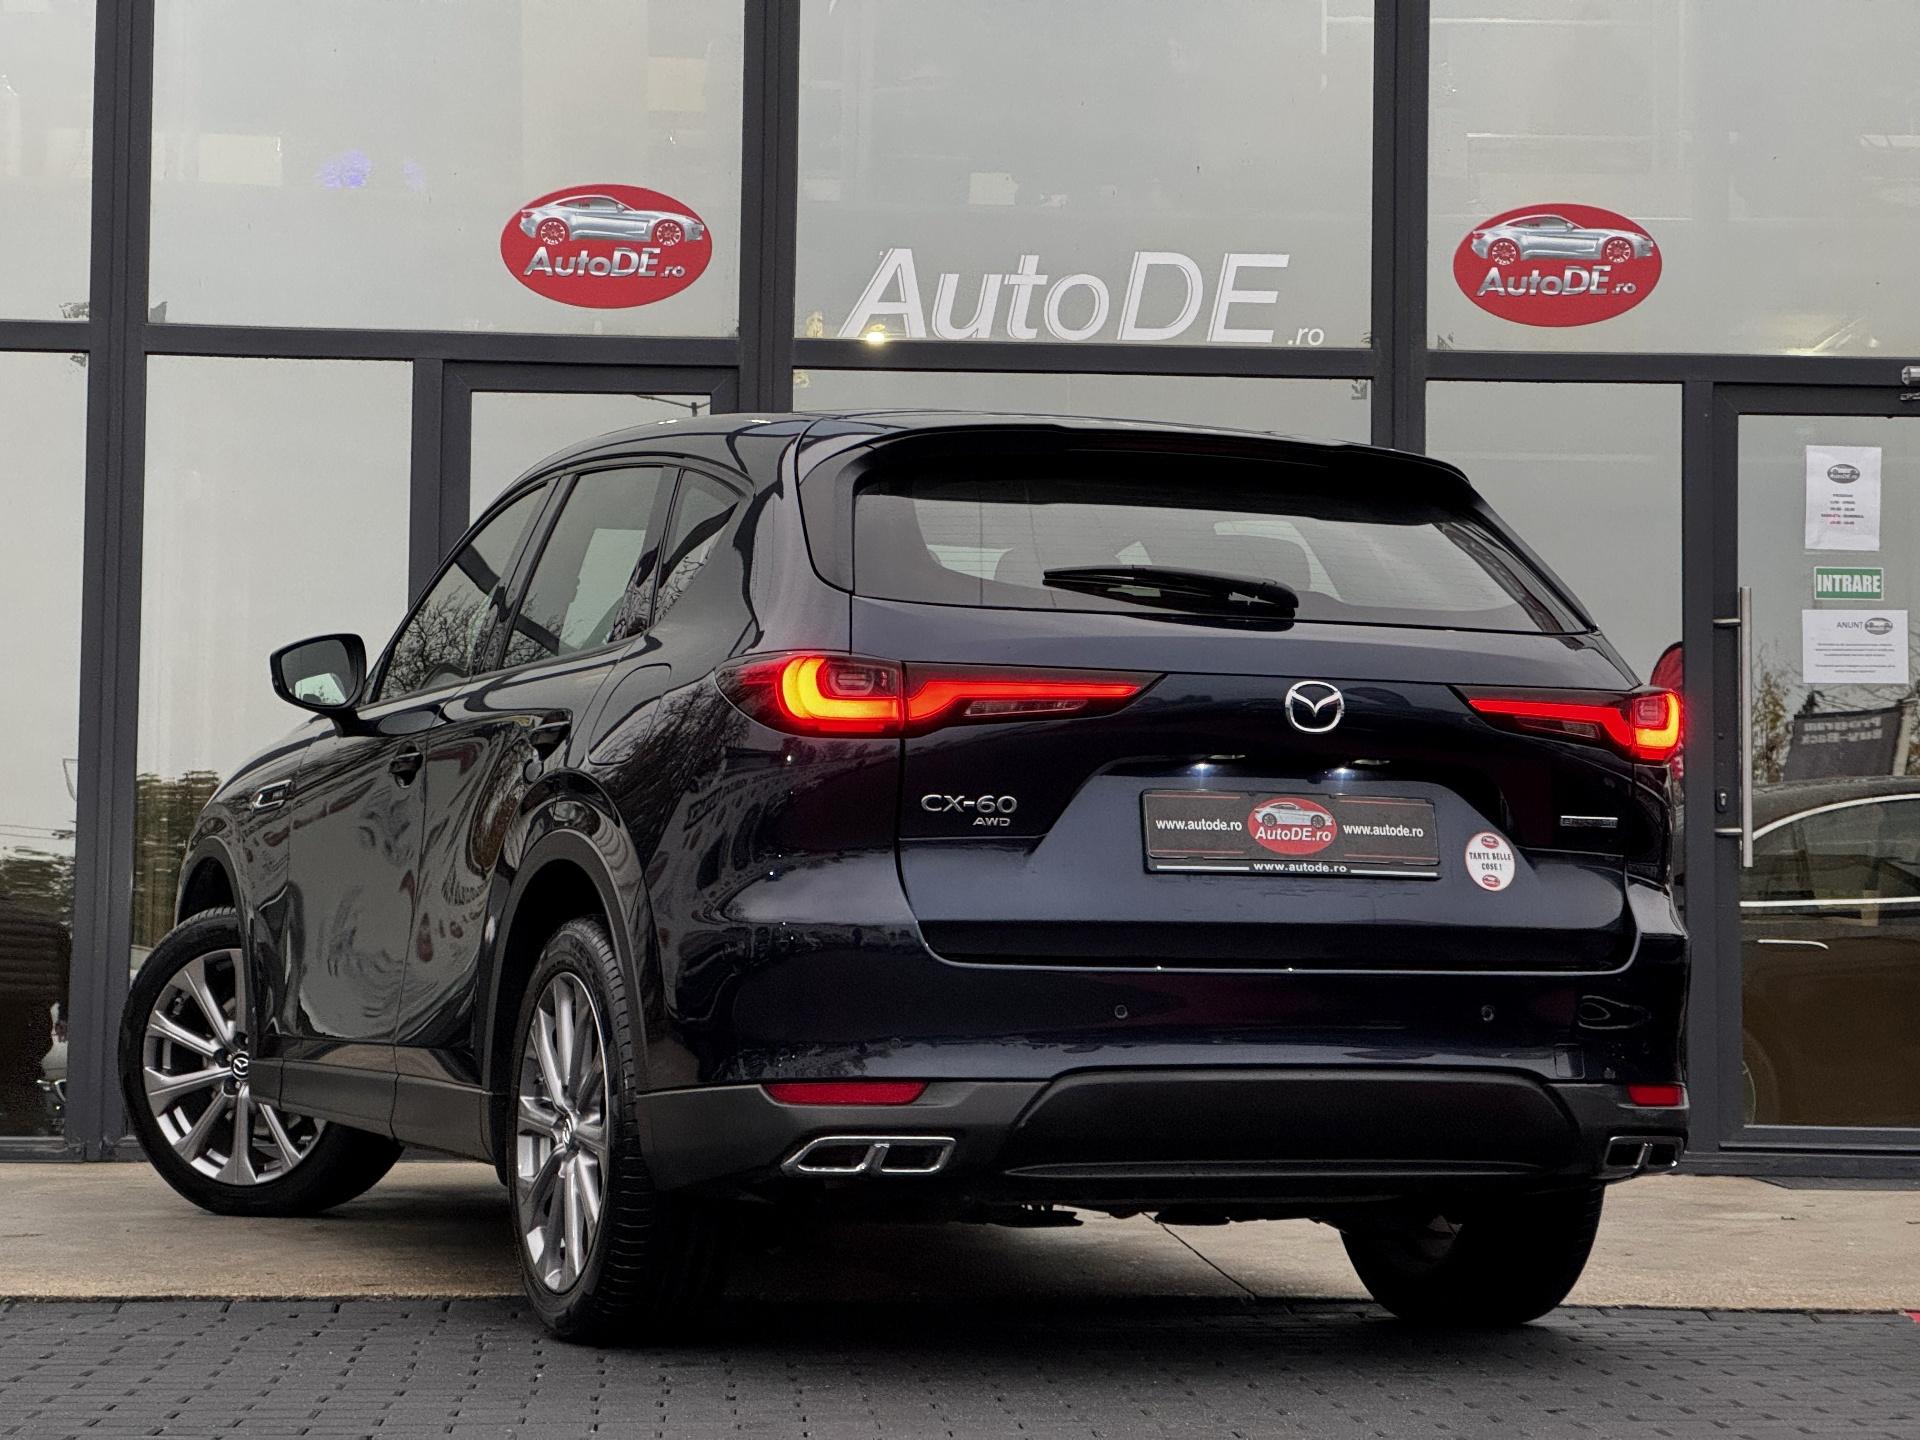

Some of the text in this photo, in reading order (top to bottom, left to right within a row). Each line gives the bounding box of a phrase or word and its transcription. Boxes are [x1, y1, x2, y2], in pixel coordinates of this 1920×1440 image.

[1816, 574, 1881, 592] INTRARE
[921, 794, 1017, 813] CX-60
[972, 817, 1011, 827] AWD
[1156, 818, 1243, 831] www.autode.ro
[1255, 827, 1332, 842] AutoDE.ro
[1343, 824, 1424, 838] www.autode.ro
[1469, 851, 1512, 861] TANTE BELLE
[1253, 861, 1348, 873] www.autode.ro
